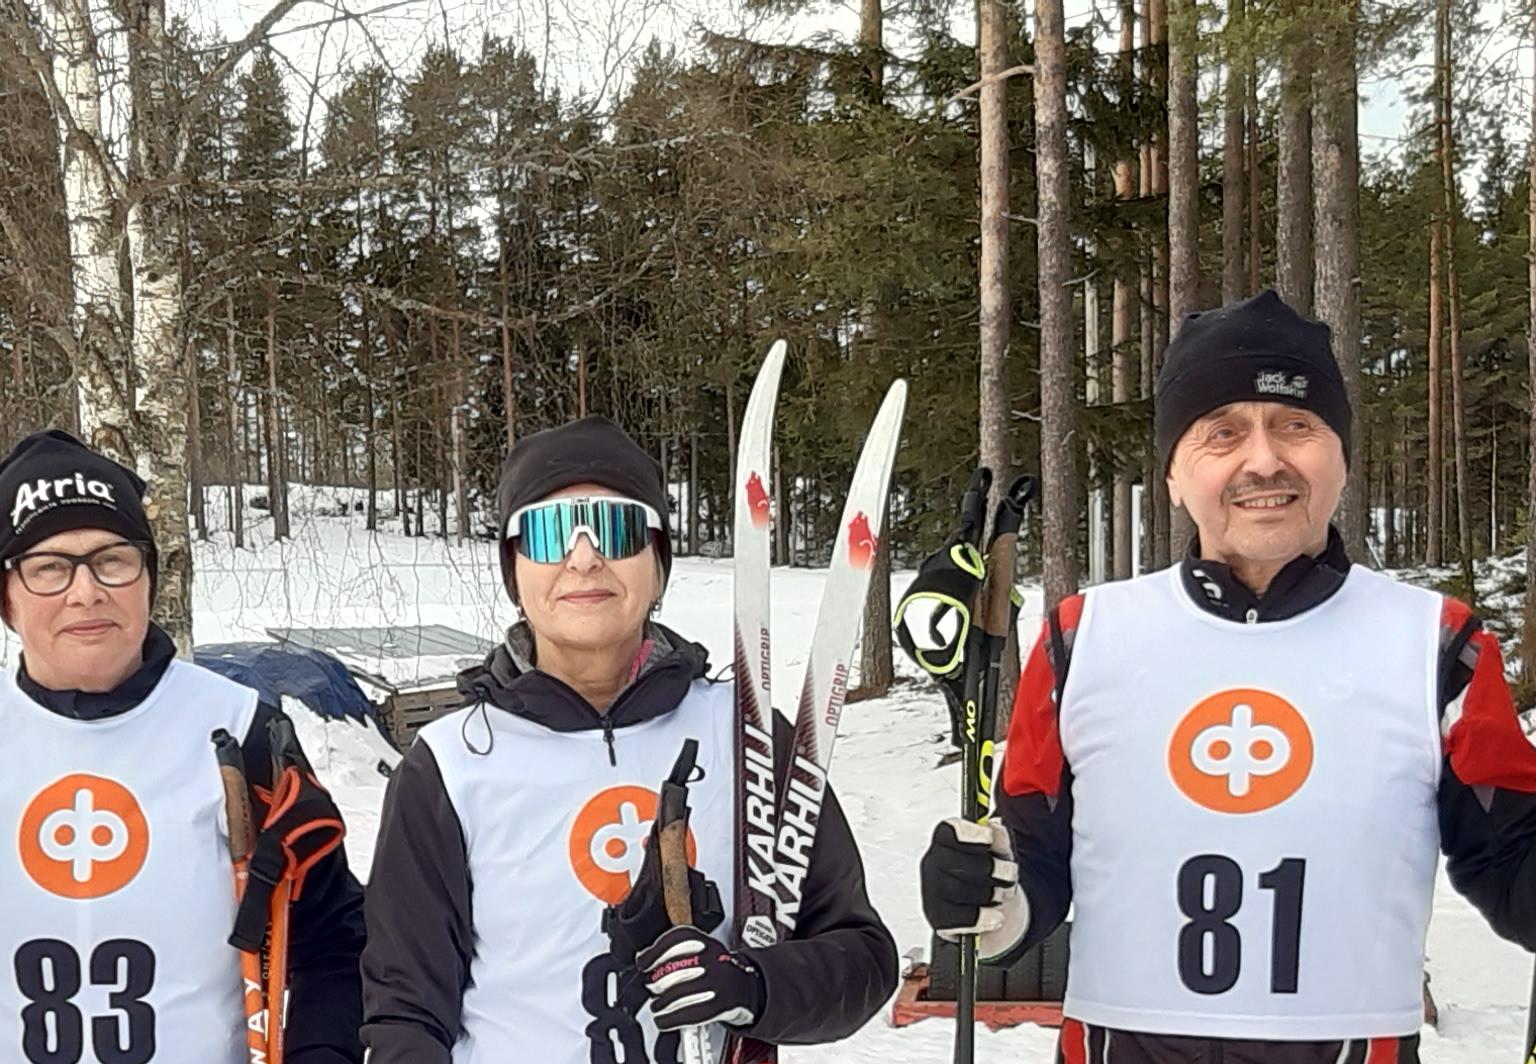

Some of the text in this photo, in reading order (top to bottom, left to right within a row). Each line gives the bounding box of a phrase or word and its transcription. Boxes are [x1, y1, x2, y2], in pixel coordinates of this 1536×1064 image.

[10, 472, 116, 526] Atria
[825, 662, 847, 727] OPTIGRIP
[745, 722, 777, 900] KARHU
[775, 756, 828, 931] KARHU
[1176, 854, 1308, 996] 81
